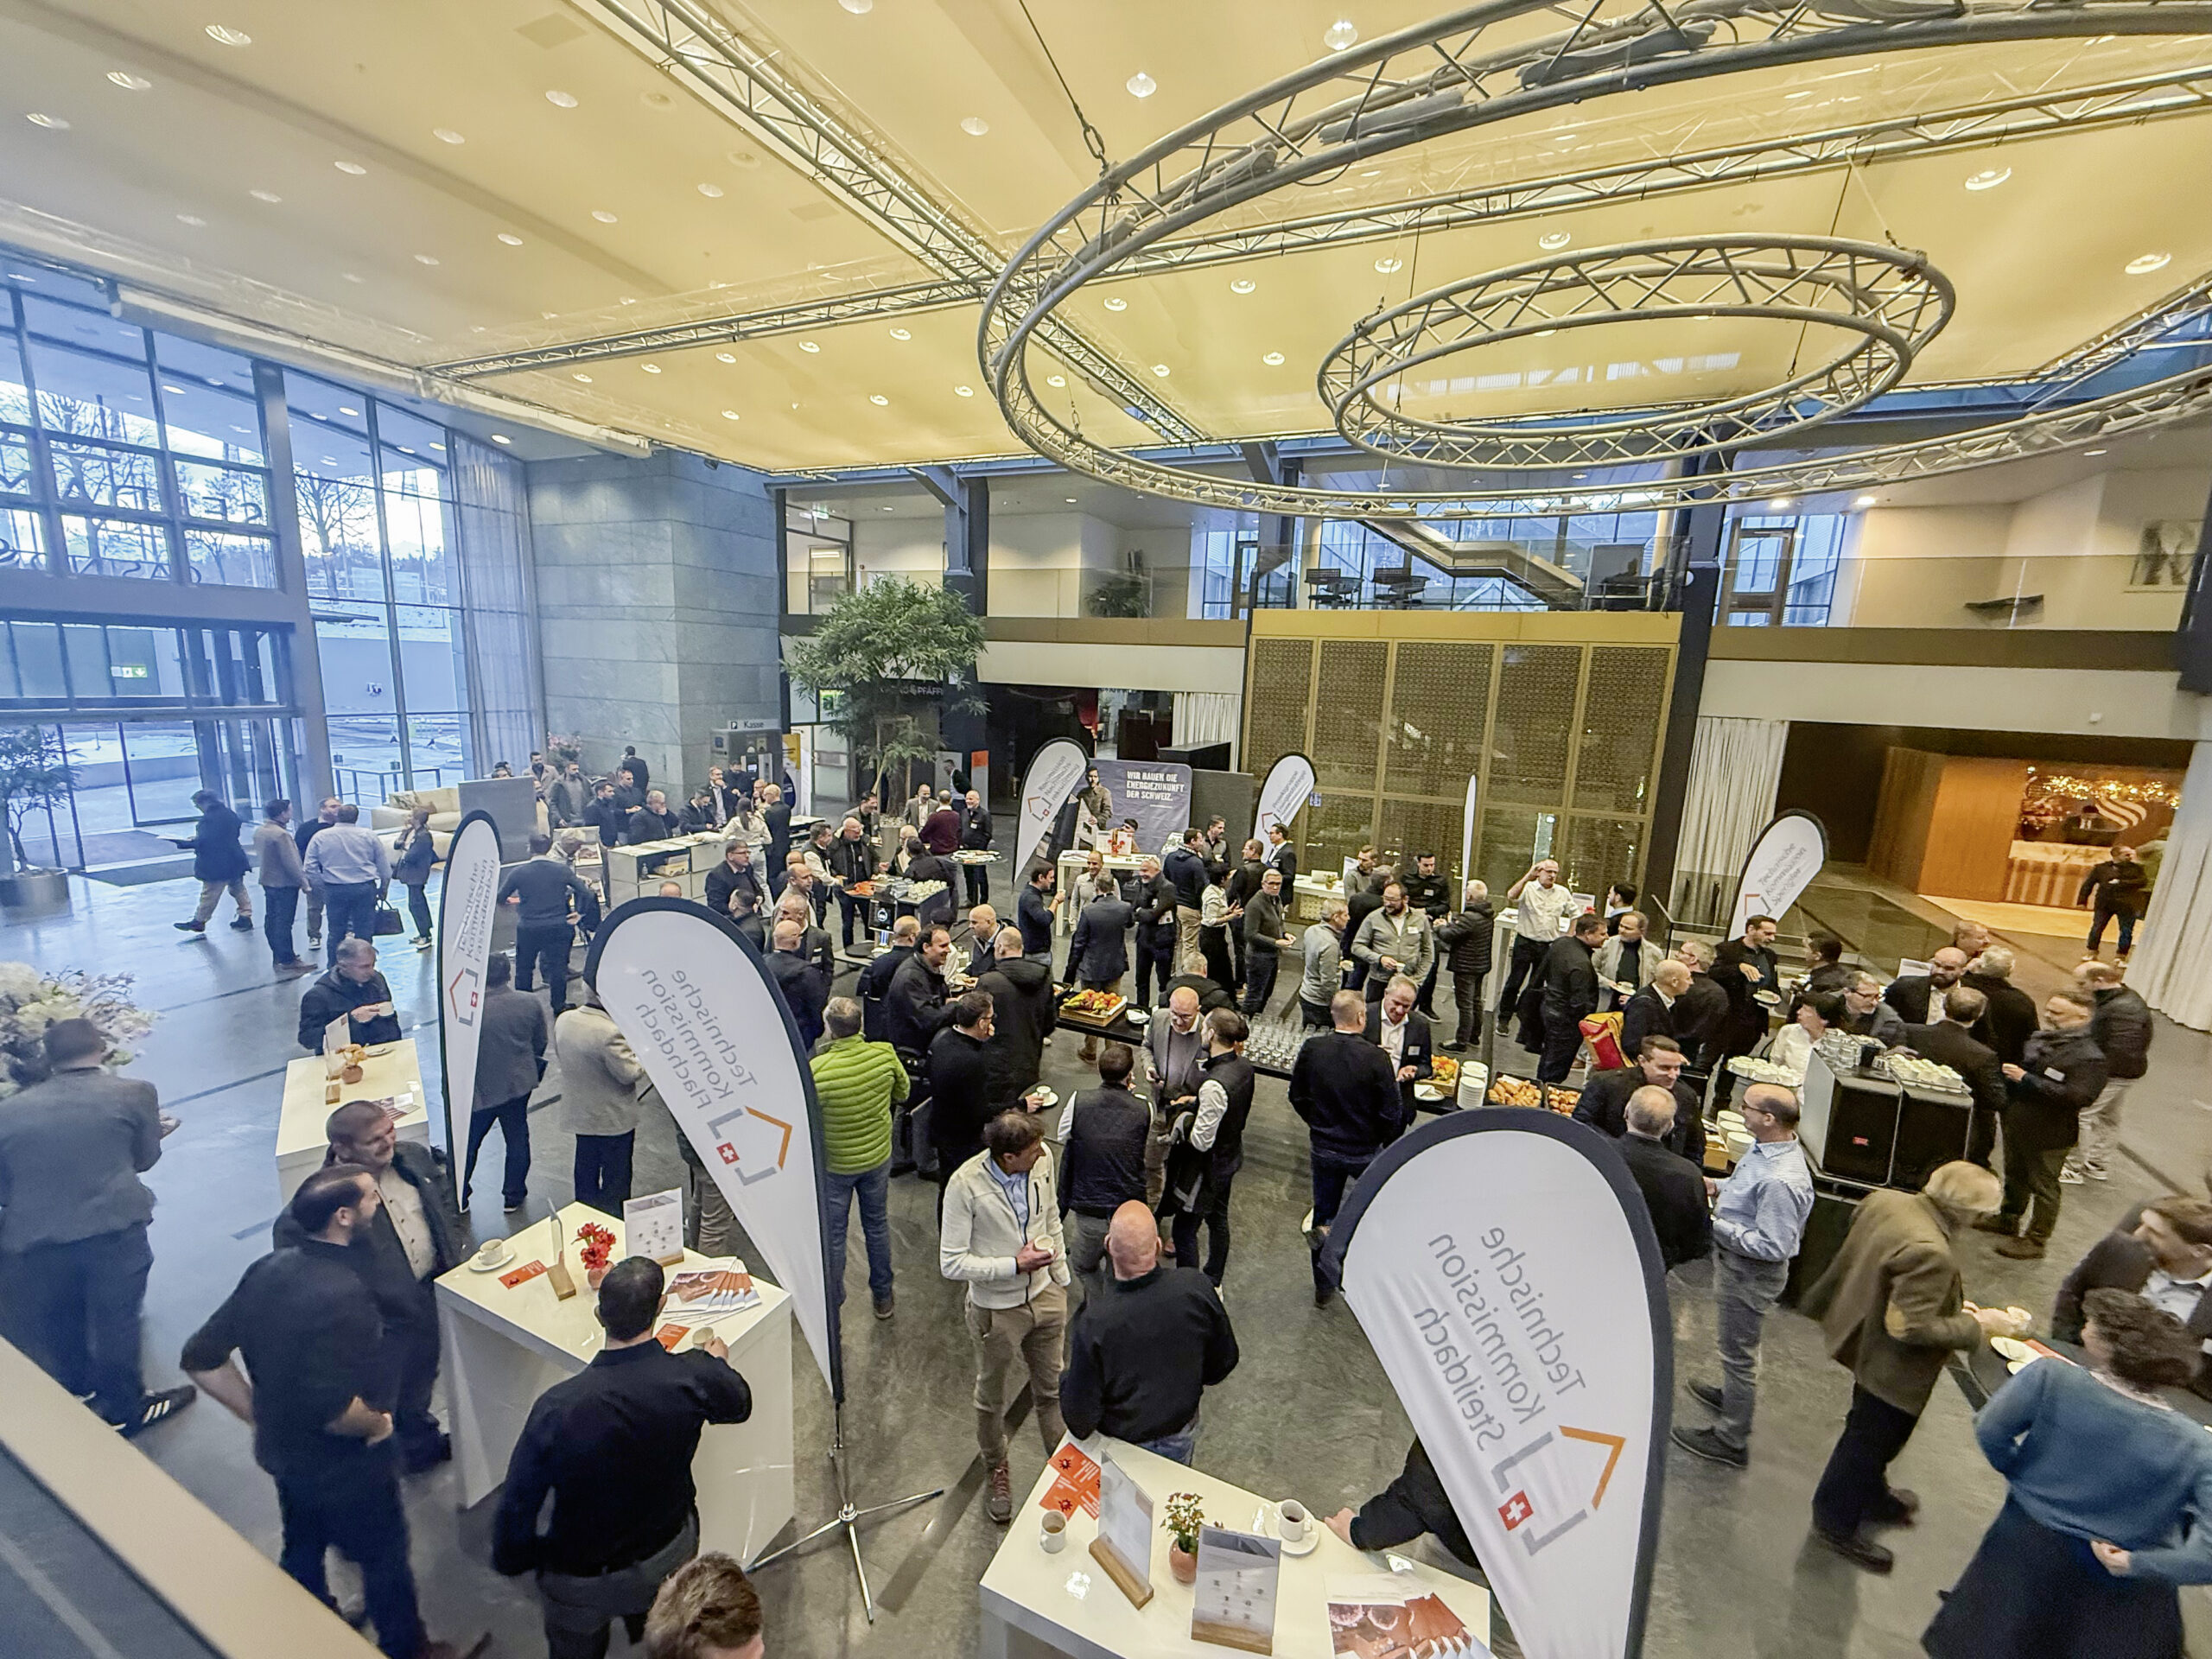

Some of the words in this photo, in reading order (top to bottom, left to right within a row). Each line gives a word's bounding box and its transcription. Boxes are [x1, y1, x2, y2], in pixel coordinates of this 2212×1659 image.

[1126, 780, 1185, 792] ENERGIEZUKUNFT
[1126, 790, 1140, 799] DER
[1141, 791, 1173, 801] SCHWEIZ.
[1127, 771, 1141, 779] WIR
[1142, 772, 1165, 781] BAUEN
[1166, 773, 1178, 782] DIE
[1759, 843, 1796, 886] Technische
[1765, 847, 1806, 896] Kommission
[457, 861, 480, 951] Technische
[465, 859, 488, 958] Kommission
[474, 859, 495, 962] Fassadenbau
